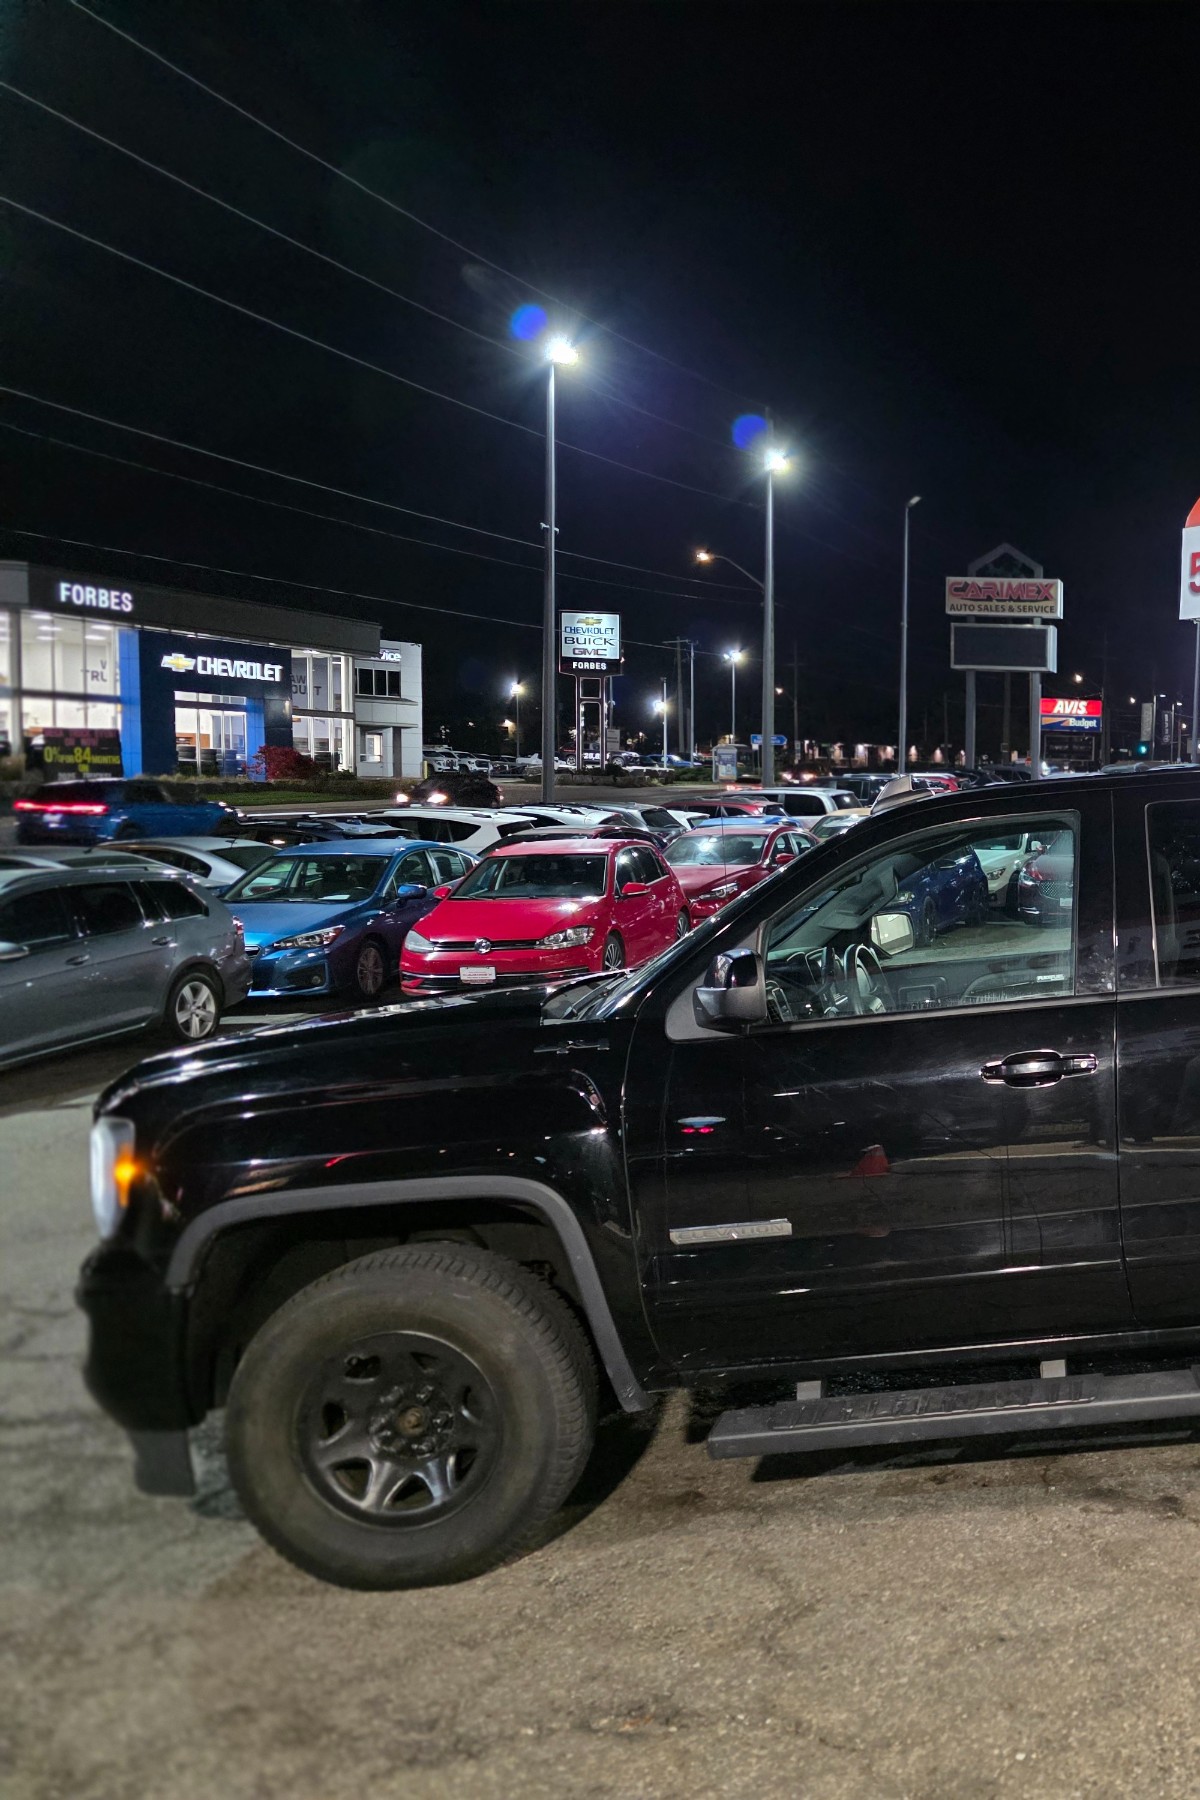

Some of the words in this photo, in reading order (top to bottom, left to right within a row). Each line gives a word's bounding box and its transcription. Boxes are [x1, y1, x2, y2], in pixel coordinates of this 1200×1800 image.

[59, 582, 133, 612] FORBES
[948, 580, 1057, 601] CARIMEX
[950, 603, 975, 612] AUTO
[977, 604, 1006, 613] SALES
[1008, 605, 1015, 613] &
[1017, 605, 1055, 614] SERVICE
[564, 625, 615, 635] CHEVROLET
[564, 636, 616, 647] BUICK
[572, 647, 607, 656] GMC
[196, 655, 283, 682] CHEVROLET
[572, 661, 607, 671] FORBES
[1052, 699, 1088, 715] AVIS
[1068, 718, 1097, 729] Budget
[73, 746, 92, 764] 84
[676, 1223, 785, 1240] ELEVATION
